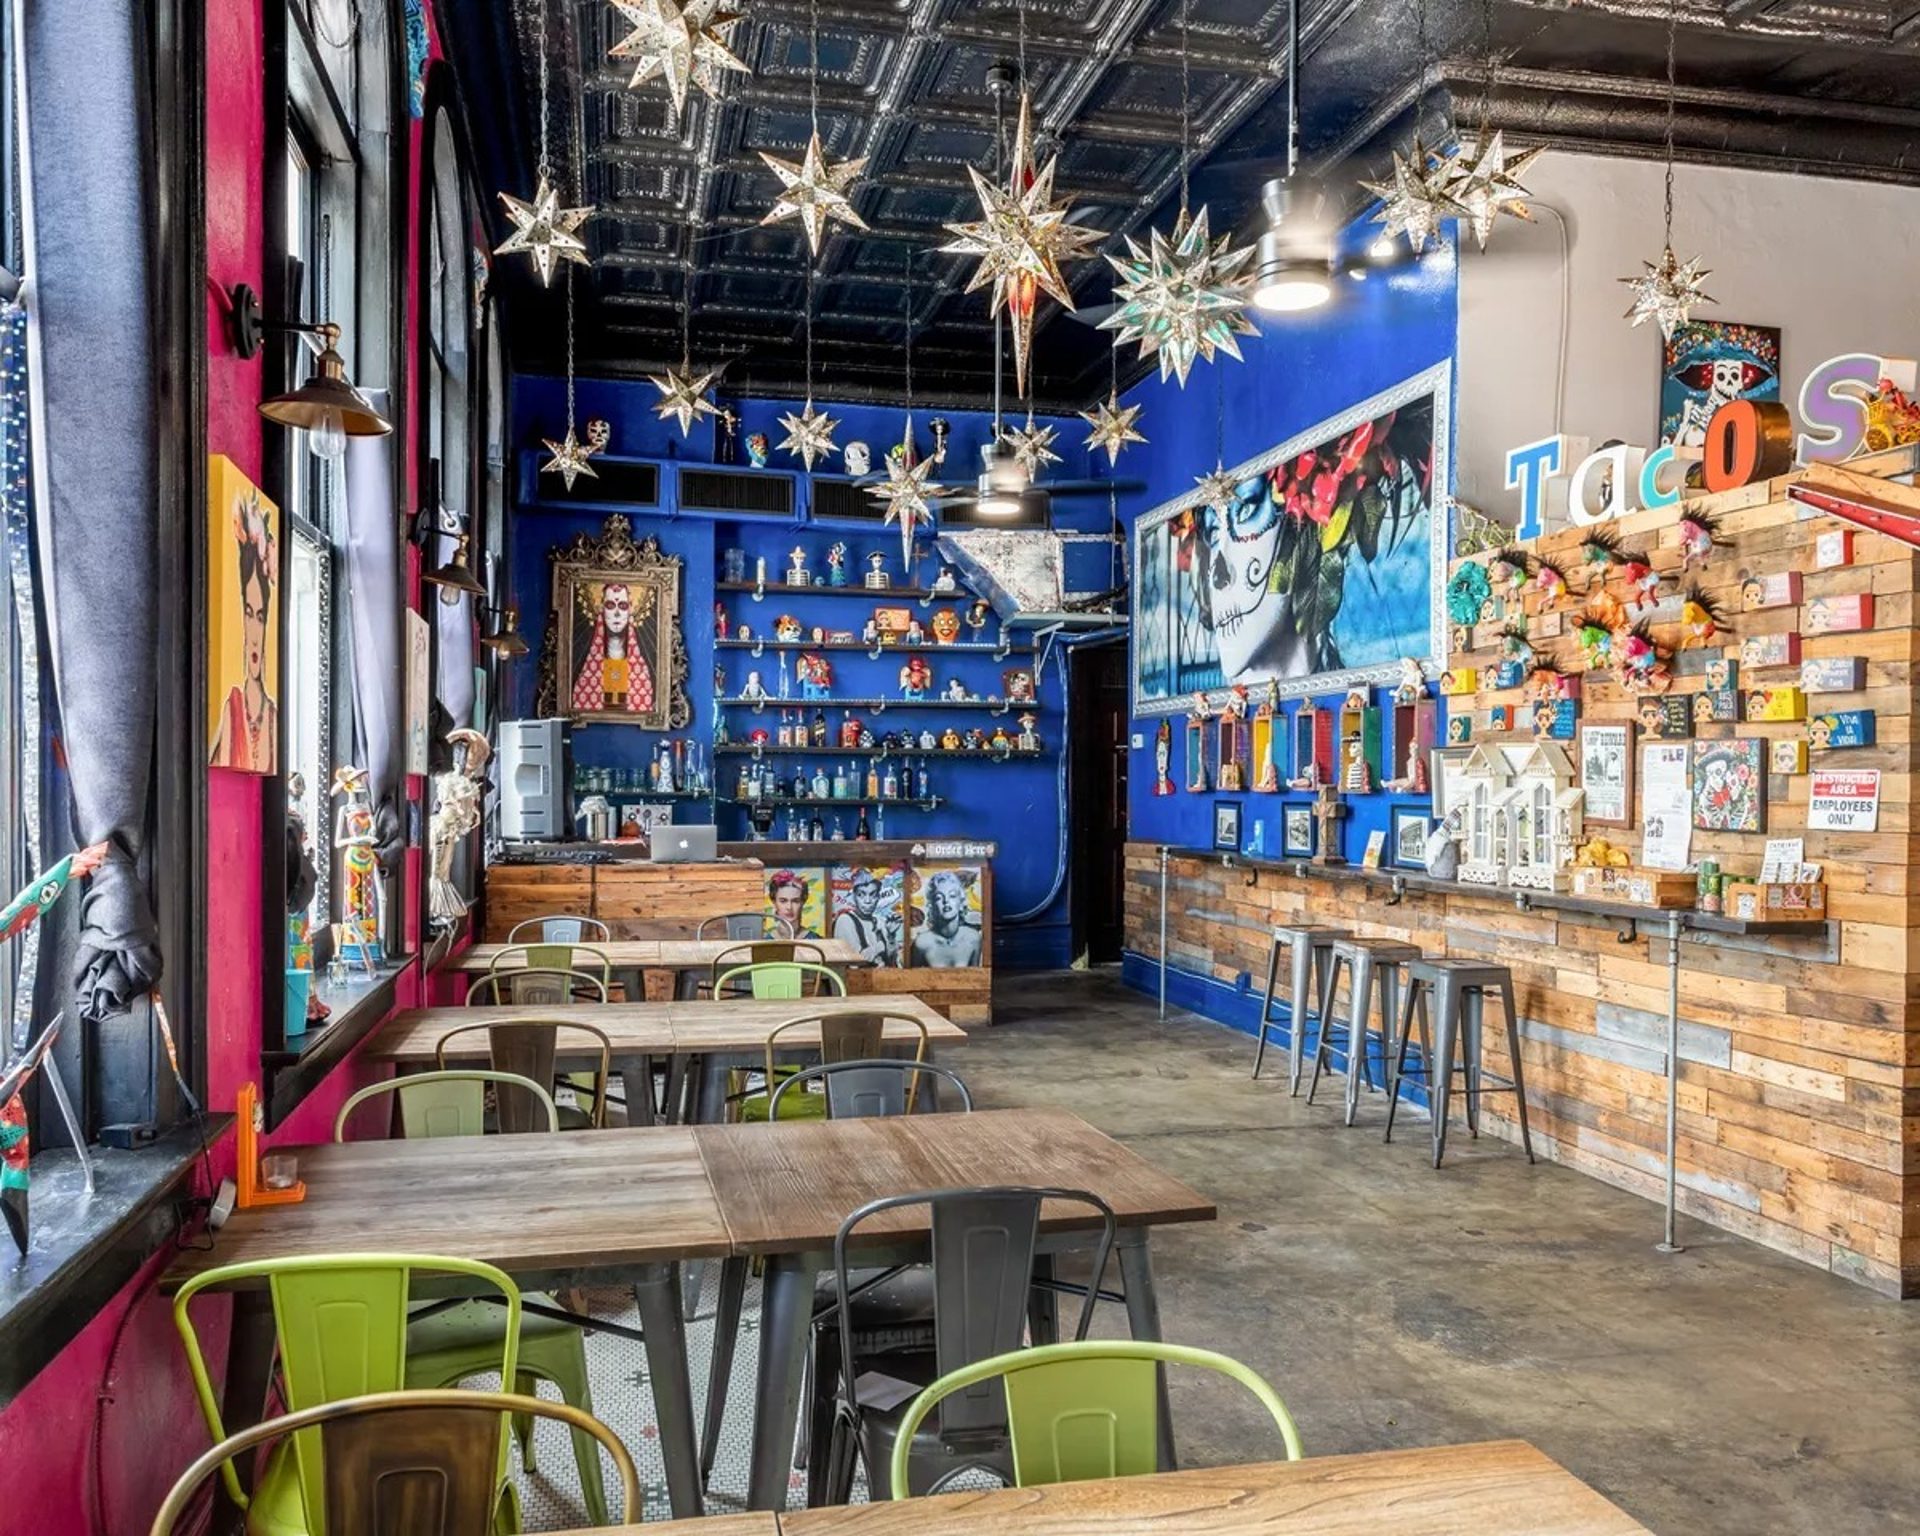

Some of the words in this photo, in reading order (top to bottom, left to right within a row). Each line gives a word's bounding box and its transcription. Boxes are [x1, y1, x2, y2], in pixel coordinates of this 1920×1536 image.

[1815, 774, 1876, 785] RESTRICTED
[1829, 784, 1858, 795] AREA
[1812, 799, 1873, 812] EMPLOYEES
[1827, 813, 1855, 825] ONLY
